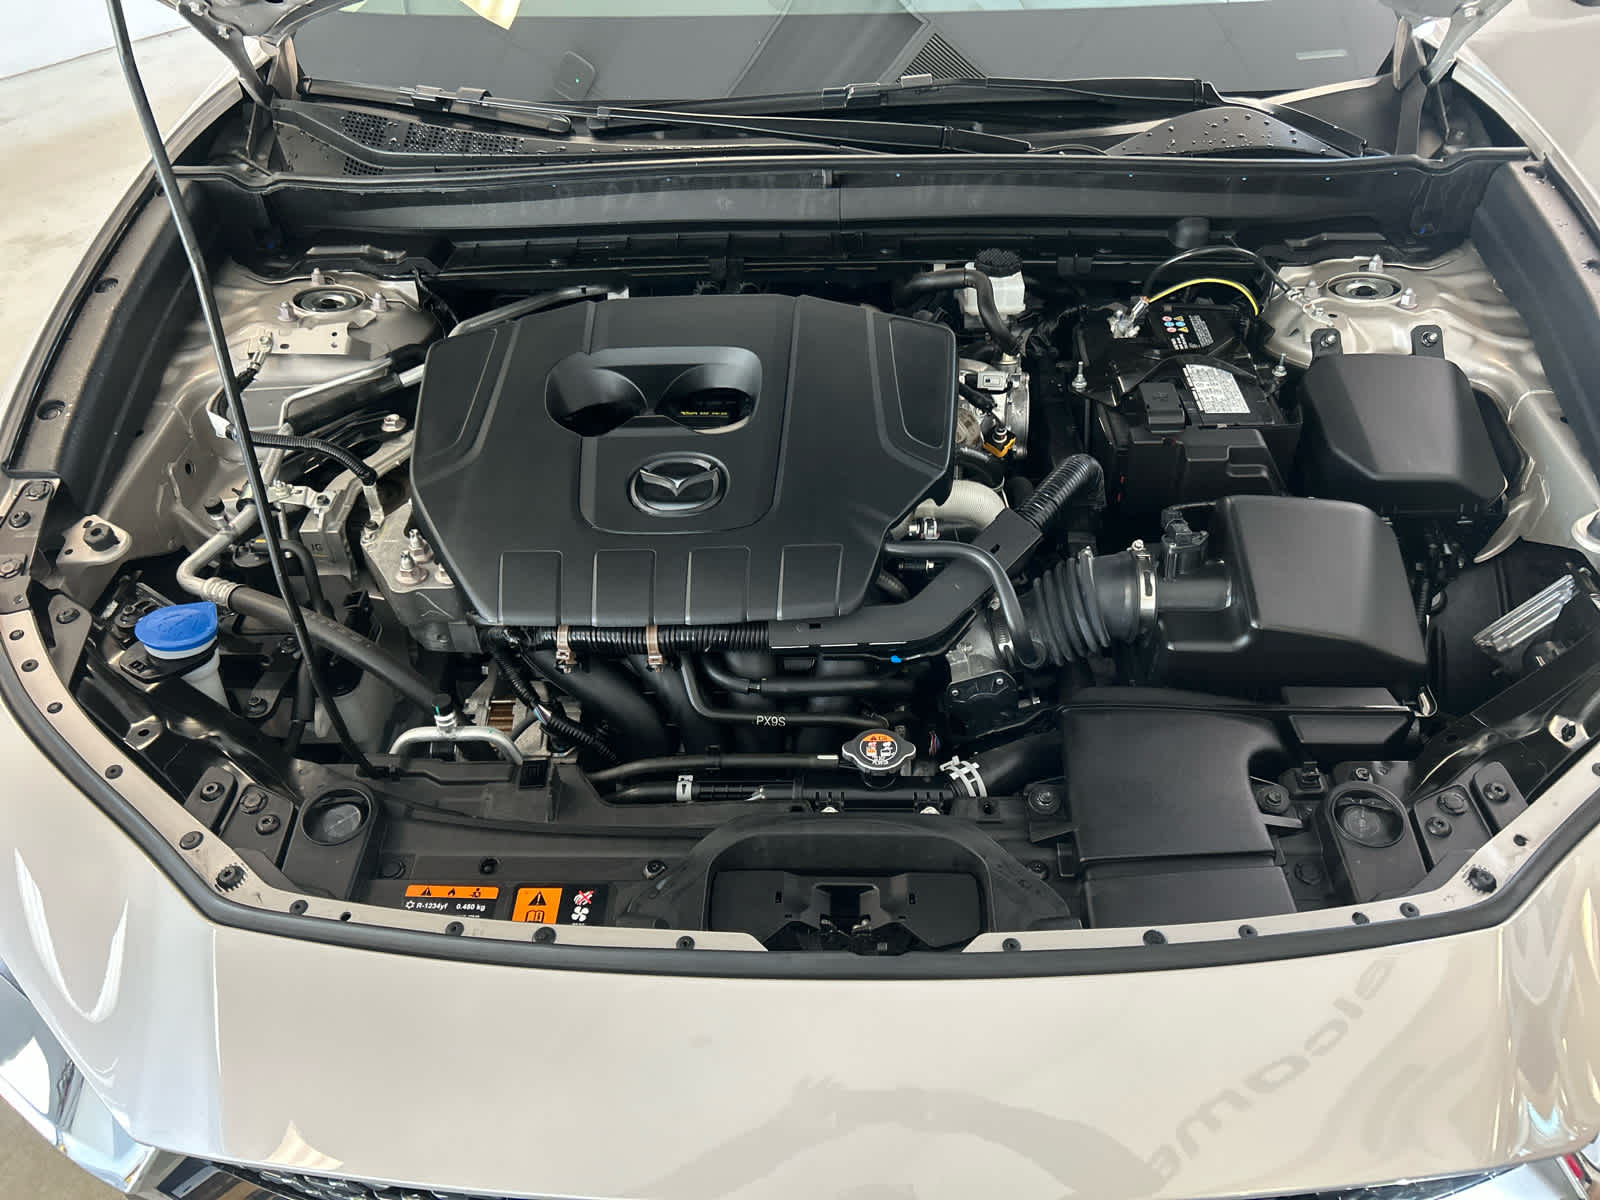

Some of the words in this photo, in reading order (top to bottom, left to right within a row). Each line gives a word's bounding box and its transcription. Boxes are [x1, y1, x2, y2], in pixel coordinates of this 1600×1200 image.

[756, 715, 786, 727] PX9S
[416, 902, 448, 911] R-1234yf
[476, 903, 486, 911] kg
